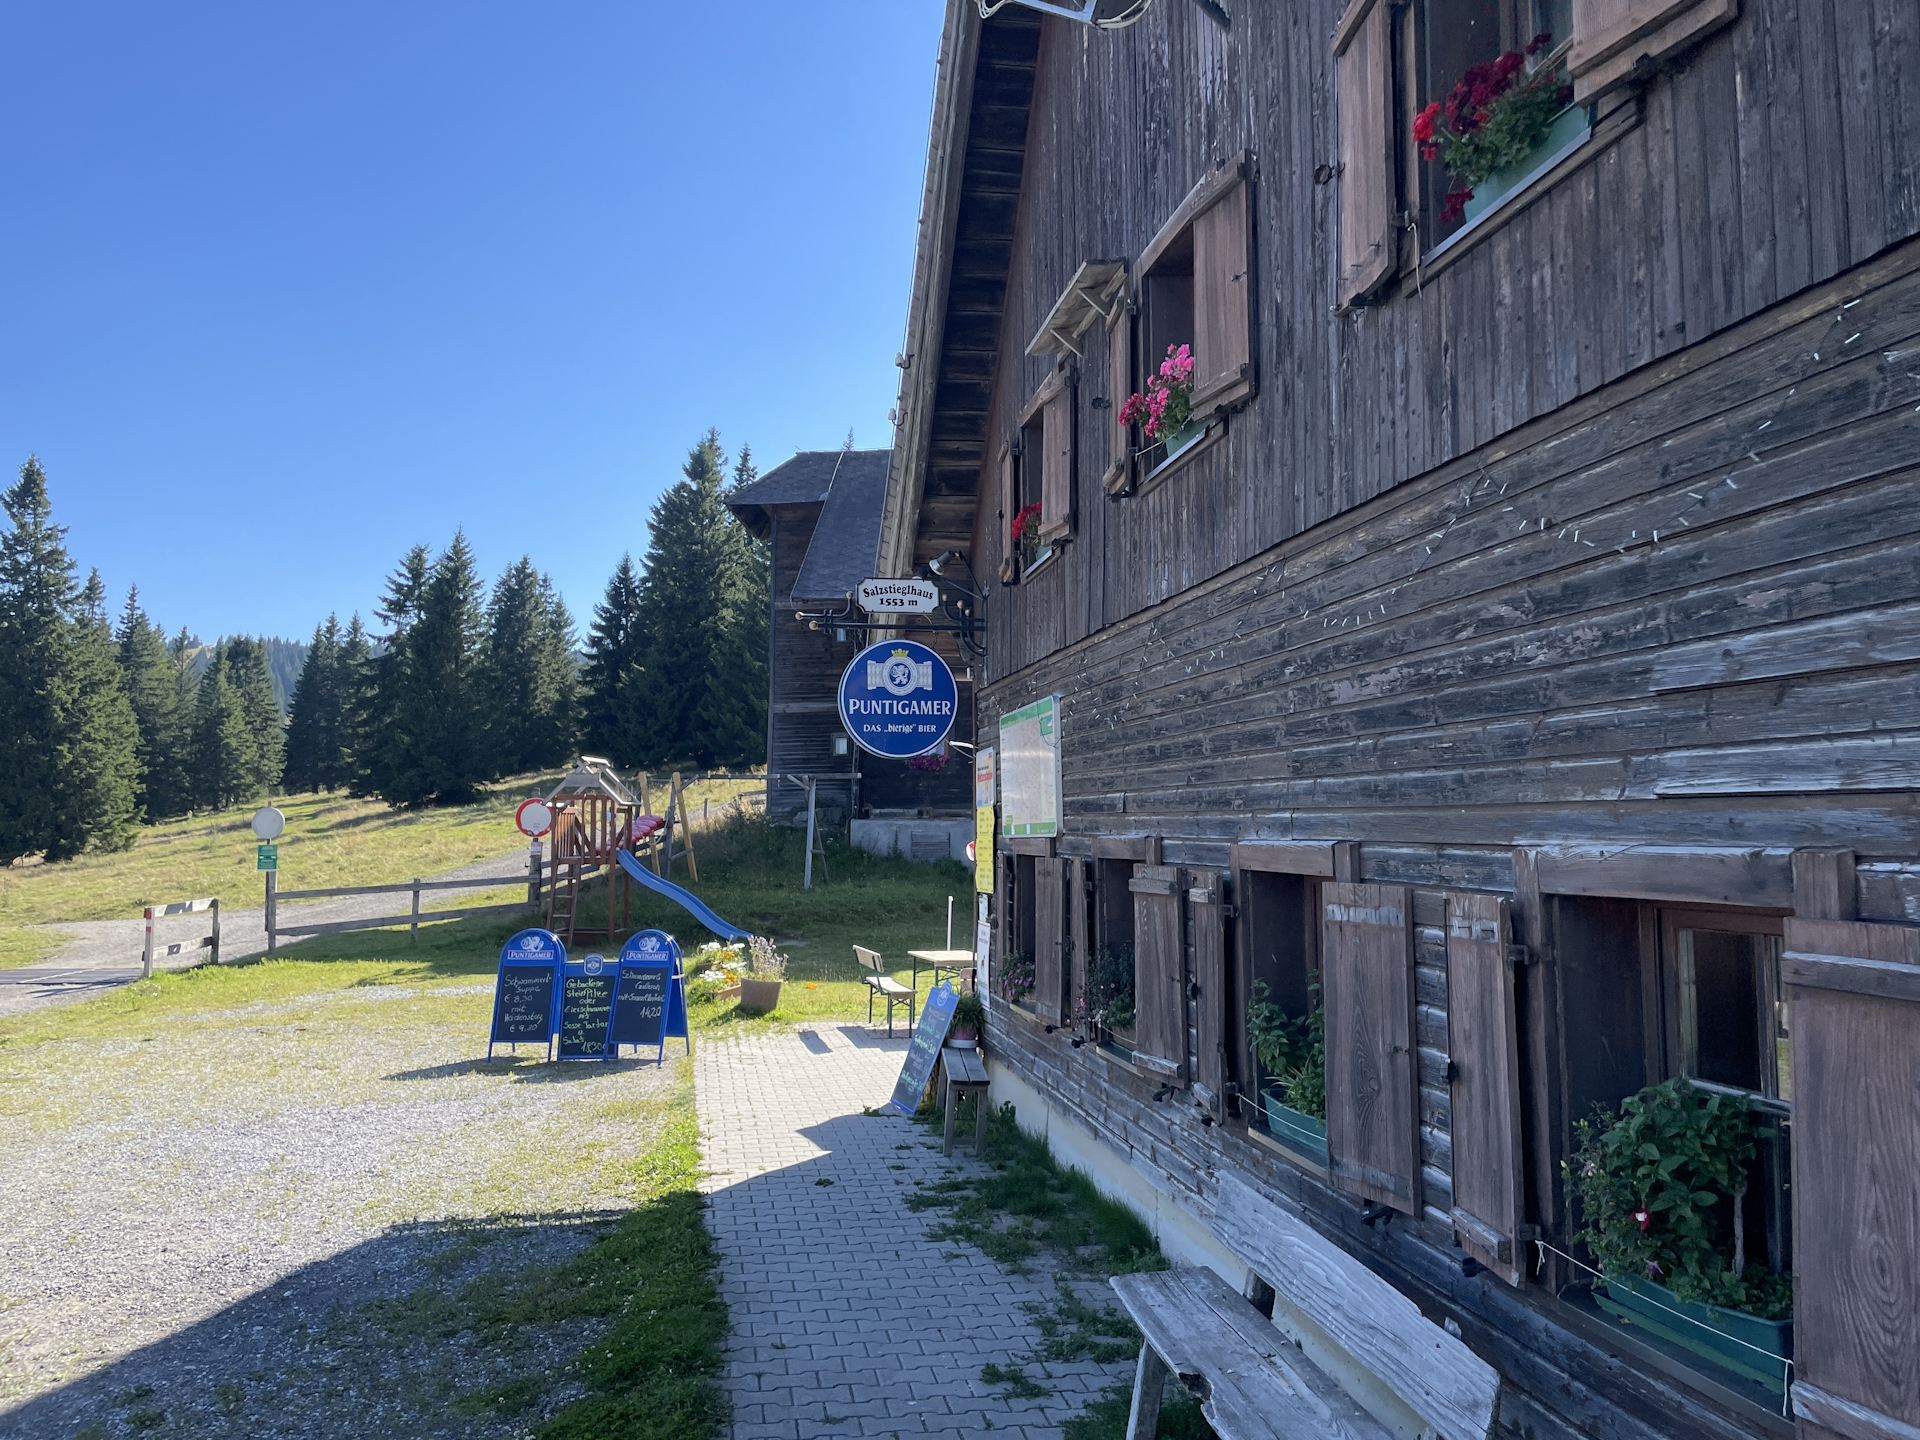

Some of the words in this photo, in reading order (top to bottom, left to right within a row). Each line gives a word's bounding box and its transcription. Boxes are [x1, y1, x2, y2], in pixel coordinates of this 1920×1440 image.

[863, 584, 934, 600] Salzstieglhaus
[879, 598, 905, 606] 1553
[849, 698, 951, 715] PUNTIGAMER
[863, 724, 882, 732] DAS
[918, 724, 937, 733] BIER
[511, 951, 551, 959] PUNTIGAMER
[511, 1004, 526, 1013] mit
